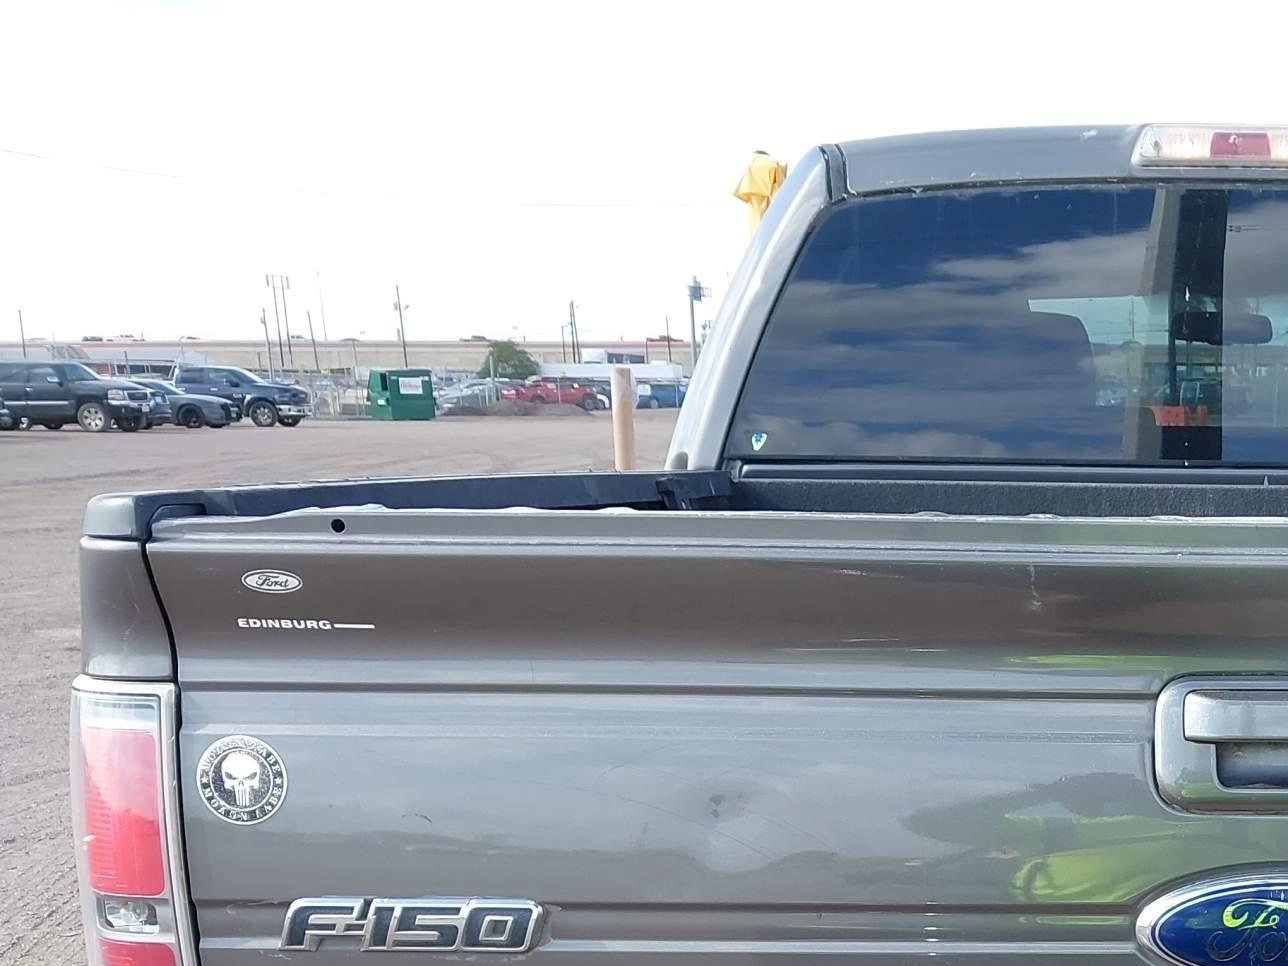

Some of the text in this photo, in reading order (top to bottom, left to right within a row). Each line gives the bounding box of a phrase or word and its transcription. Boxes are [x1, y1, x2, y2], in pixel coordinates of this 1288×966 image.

[255, 574, 290, 589] Ford
[237, 618, 332, 630] EDINBURG
[278, 895, 545, 953] F-150
